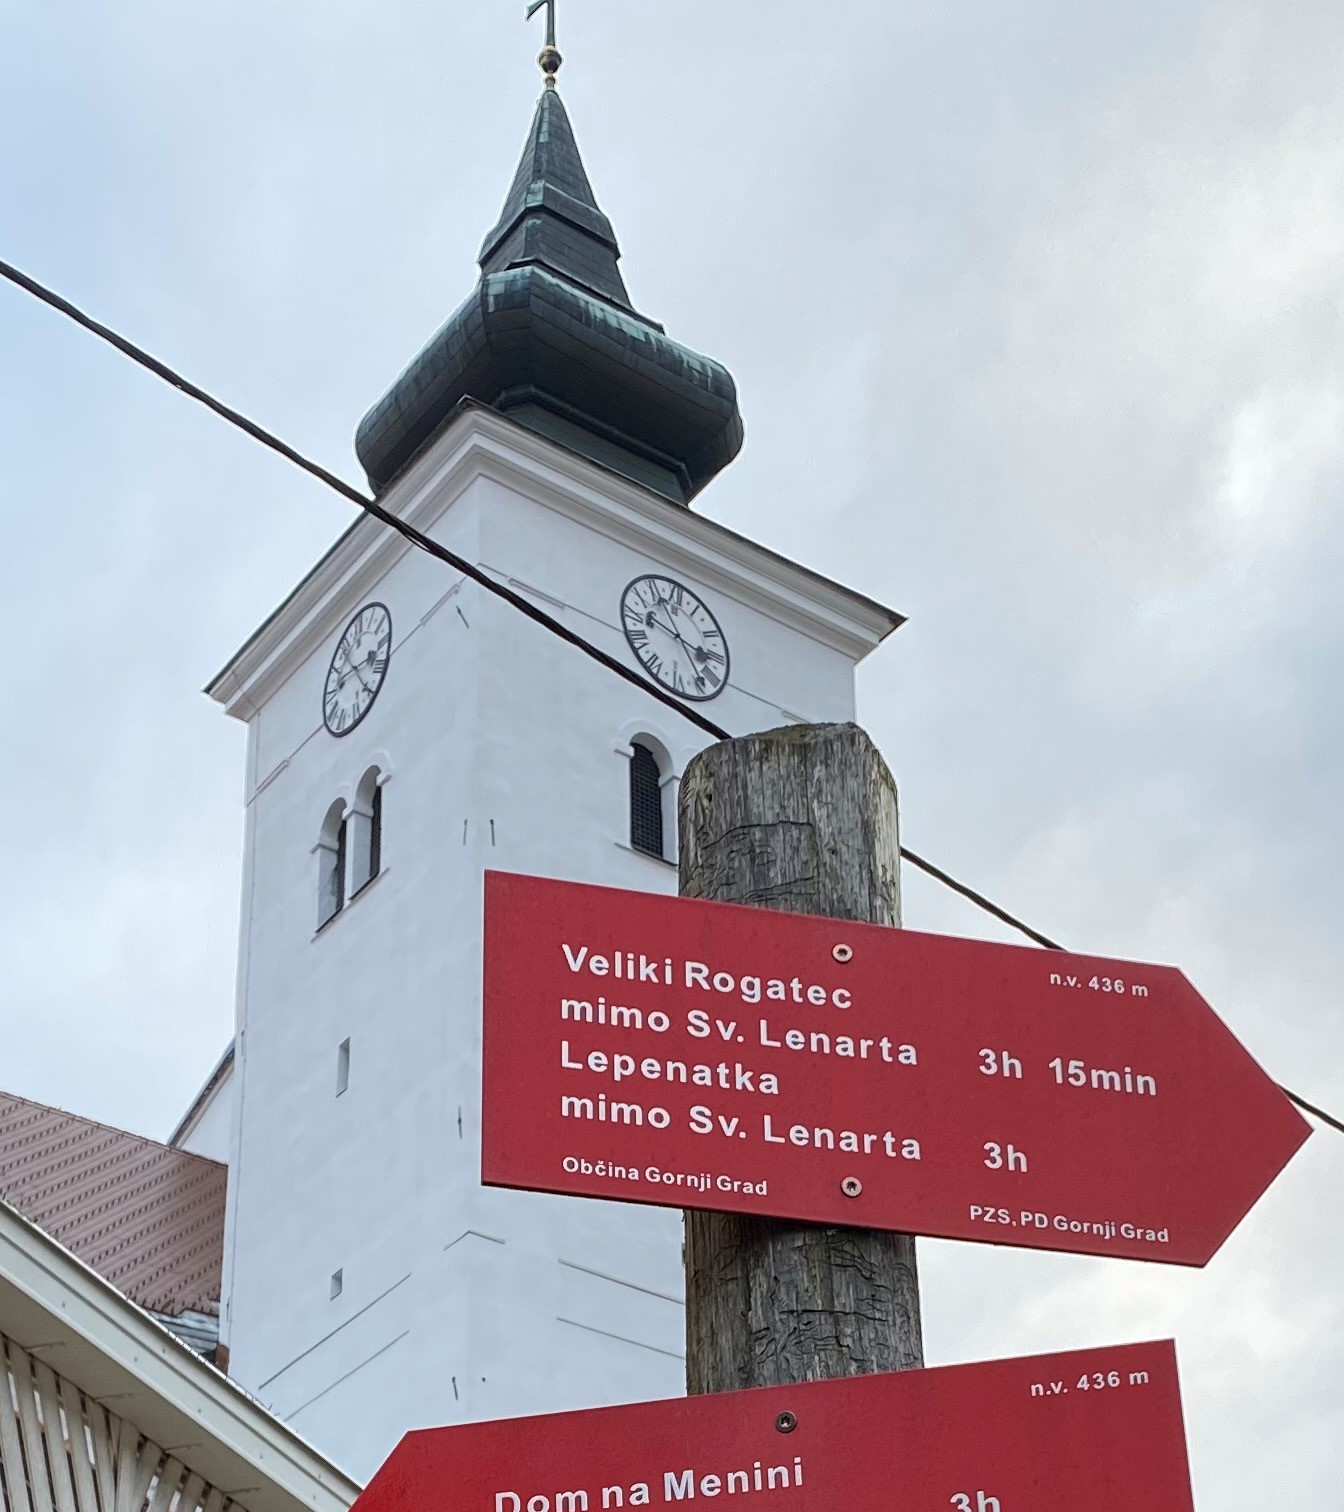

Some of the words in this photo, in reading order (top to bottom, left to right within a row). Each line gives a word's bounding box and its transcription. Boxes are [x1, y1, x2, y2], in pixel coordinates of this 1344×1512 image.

[561, 943, 673, 985] Veliki
[685, 960, 852, 1009] Rogatec
[1049, 973, 1082, 988] n.v.
[1088, 975, 1125, 994] 436
[1131, 985, 1149, 998] m
[561, 996, 670, 1033] mimo
[686, 1009, 744, 1043] Sv.
[759, 1019, 918, 1066] Lenarta
[561, 1040, 779, 1095] Lepenatka
[978, 1048, 1023, 1079] 3h
[1048, 1057, 1157, 1096] 15min
[561, 1093, 671, 1129] mimo
[689, 1105, 747, 1139] Sv.
[763, 1114, 921, 1160] Lenarta
[562, 1156, 640, 1181] Občina
[644, 1166, 711, 1192] Gornji
[716, 1175, 768, 1196] Grad
[983, 1141, 1028, 1173] 3h
[1020, 1211, 1049, 1229] PD
[1053, 1215, 1116, 1240] Gornji
[1120, 1223, 1169, 1243] Grad
[1030, 1381, 1068, 1397] n.v.
[1076, 1370, 1121, 1391] 436
[1128, 1371, 1149, 1385] m
[601, 1482, 650, 1509] na
[663, 1456, 803, 1502] Menini
